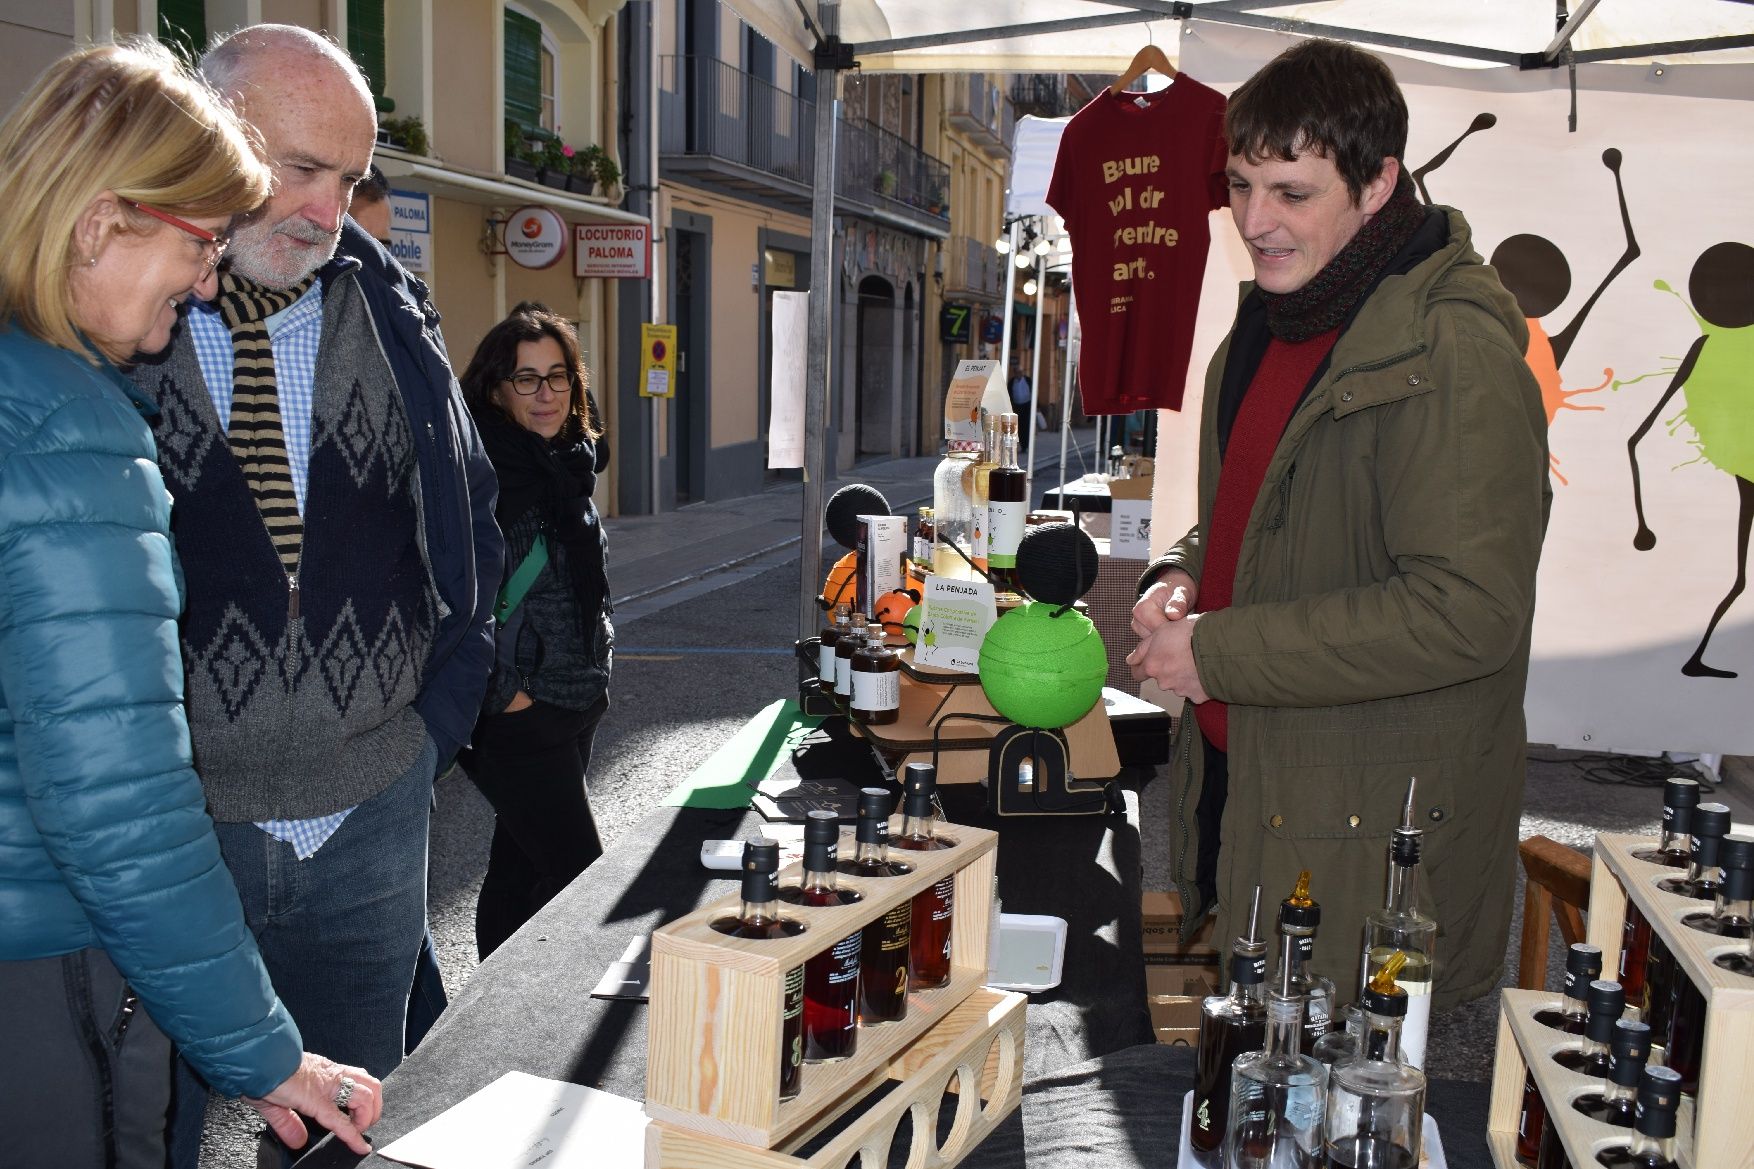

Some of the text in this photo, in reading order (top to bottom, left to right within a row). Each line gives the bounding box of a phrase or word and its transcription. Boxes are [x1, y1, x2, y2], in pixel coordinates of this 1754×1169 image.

[1103, 155, 1160, 184] Beure
[394, 206, 426, 221] PALOMA
[579, 229, 643, 241] LOCUTORIO
[511, 240, 554, 250] MoneyGram
[588, 246, 633, 258] PALOMA
[949, 307, 967, 336] 7
[935, 583, 978, 596] LA PENJADA
[895, 966, 907, 995] 2
